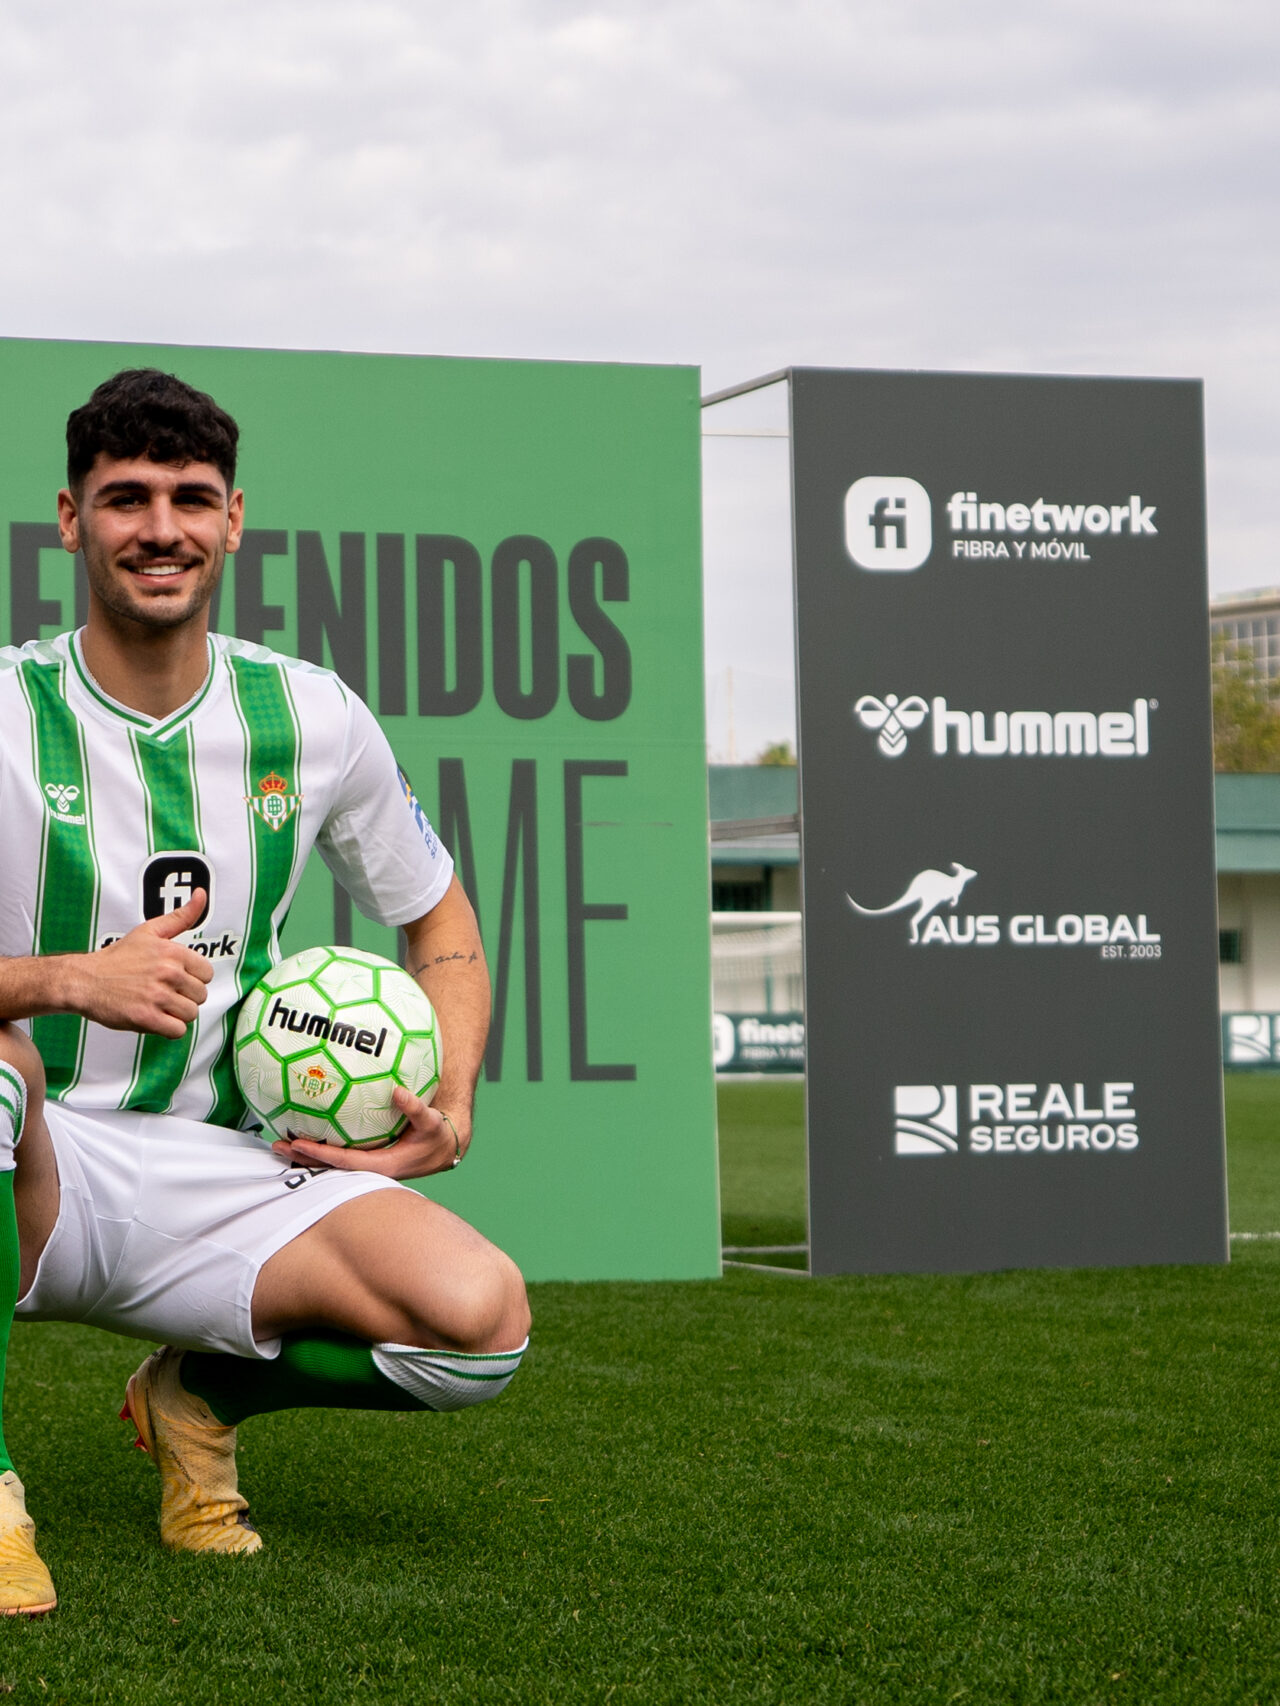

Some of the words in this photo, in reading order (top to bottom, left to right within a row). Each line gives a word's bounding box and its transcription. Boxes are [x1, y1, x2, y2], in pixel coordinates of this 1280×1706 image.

[947, 491, 1159, 534] finetwork
[952, 540, 1010, 558] FIBRA
[1012, 541, 1028, 559] Y
[1031, 537, 1091, 560] MÓVIL
[922, 914, 1001, 944] AUS
[1010, 913, 1162, 944] GLOBAL
[1102, 944, 1128, 959] EST.
[1130, 944, 1163, 959] 2003
[268, 997, 388, 1058] hummel
[970, 1081, 1137, 1121] REALE
[970, 1123, 1140, 1153] SEGUROS
